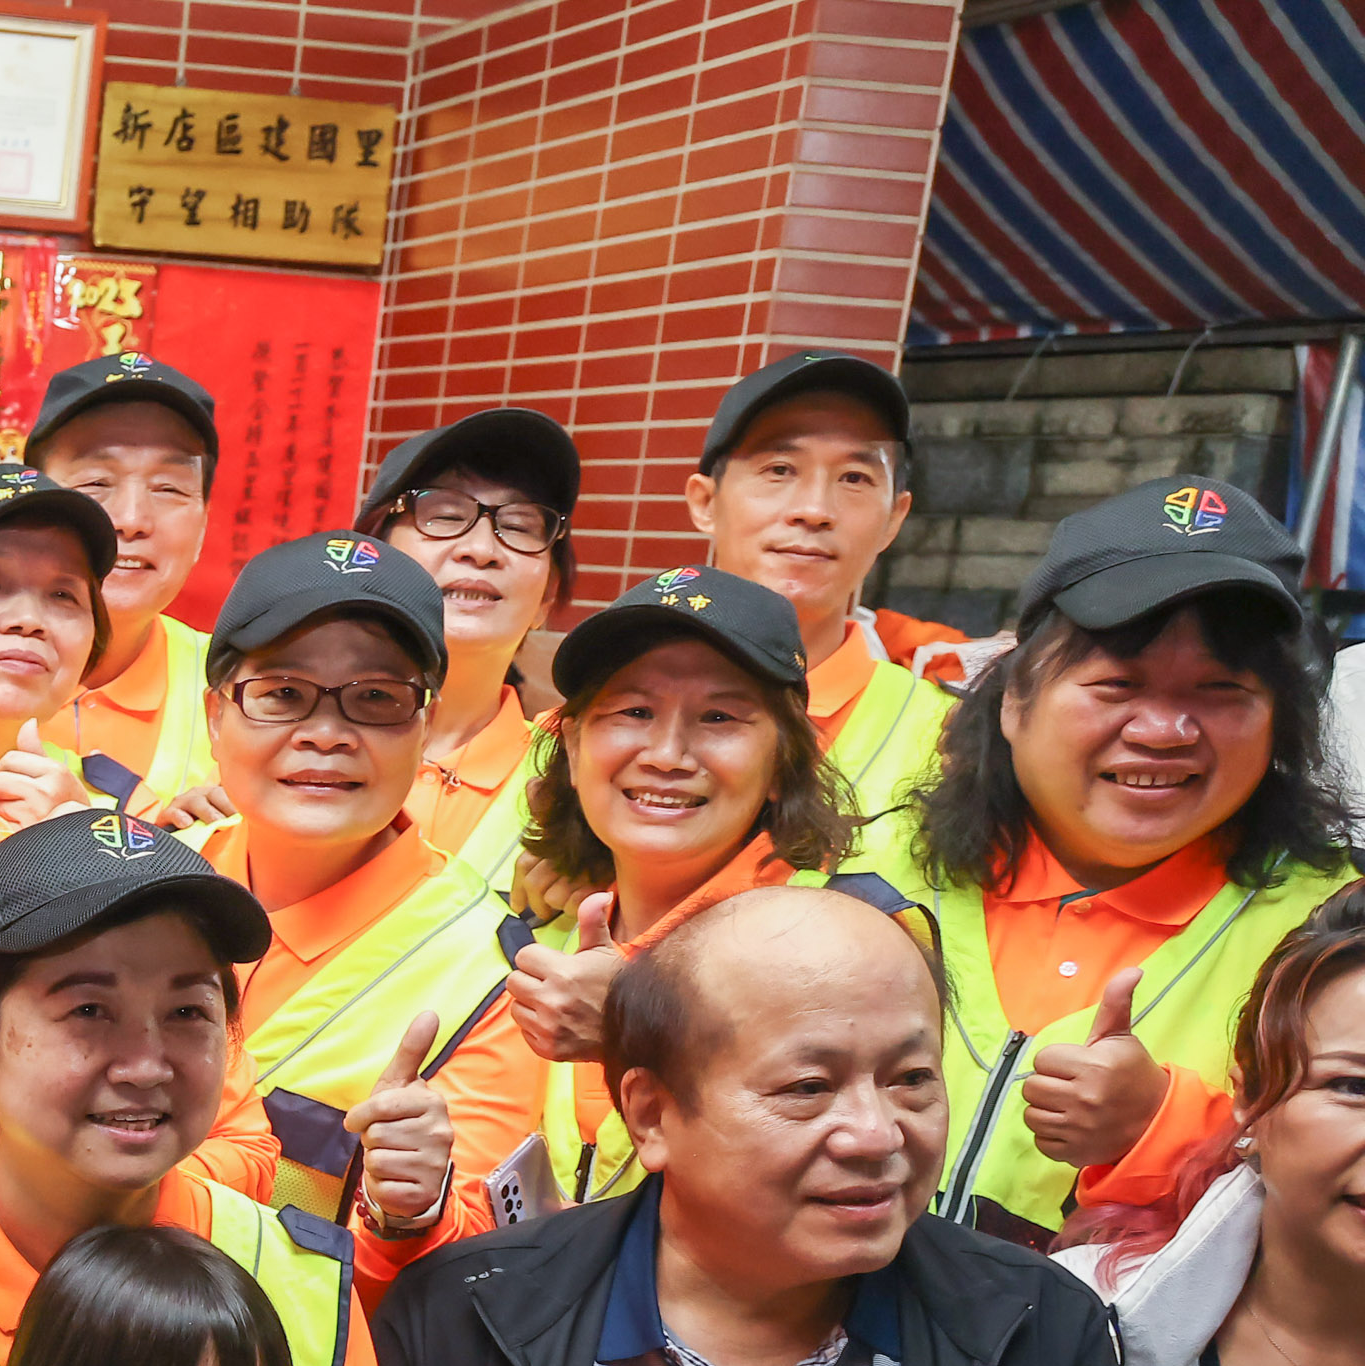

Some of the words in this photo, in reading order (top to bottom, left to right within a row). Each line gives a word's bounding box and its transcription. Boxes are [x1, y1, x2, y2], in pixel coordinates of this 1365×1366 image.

[113, 102, 383, 168] 新店區建國里
[128, 184, 364, 240] 守望相助隊
